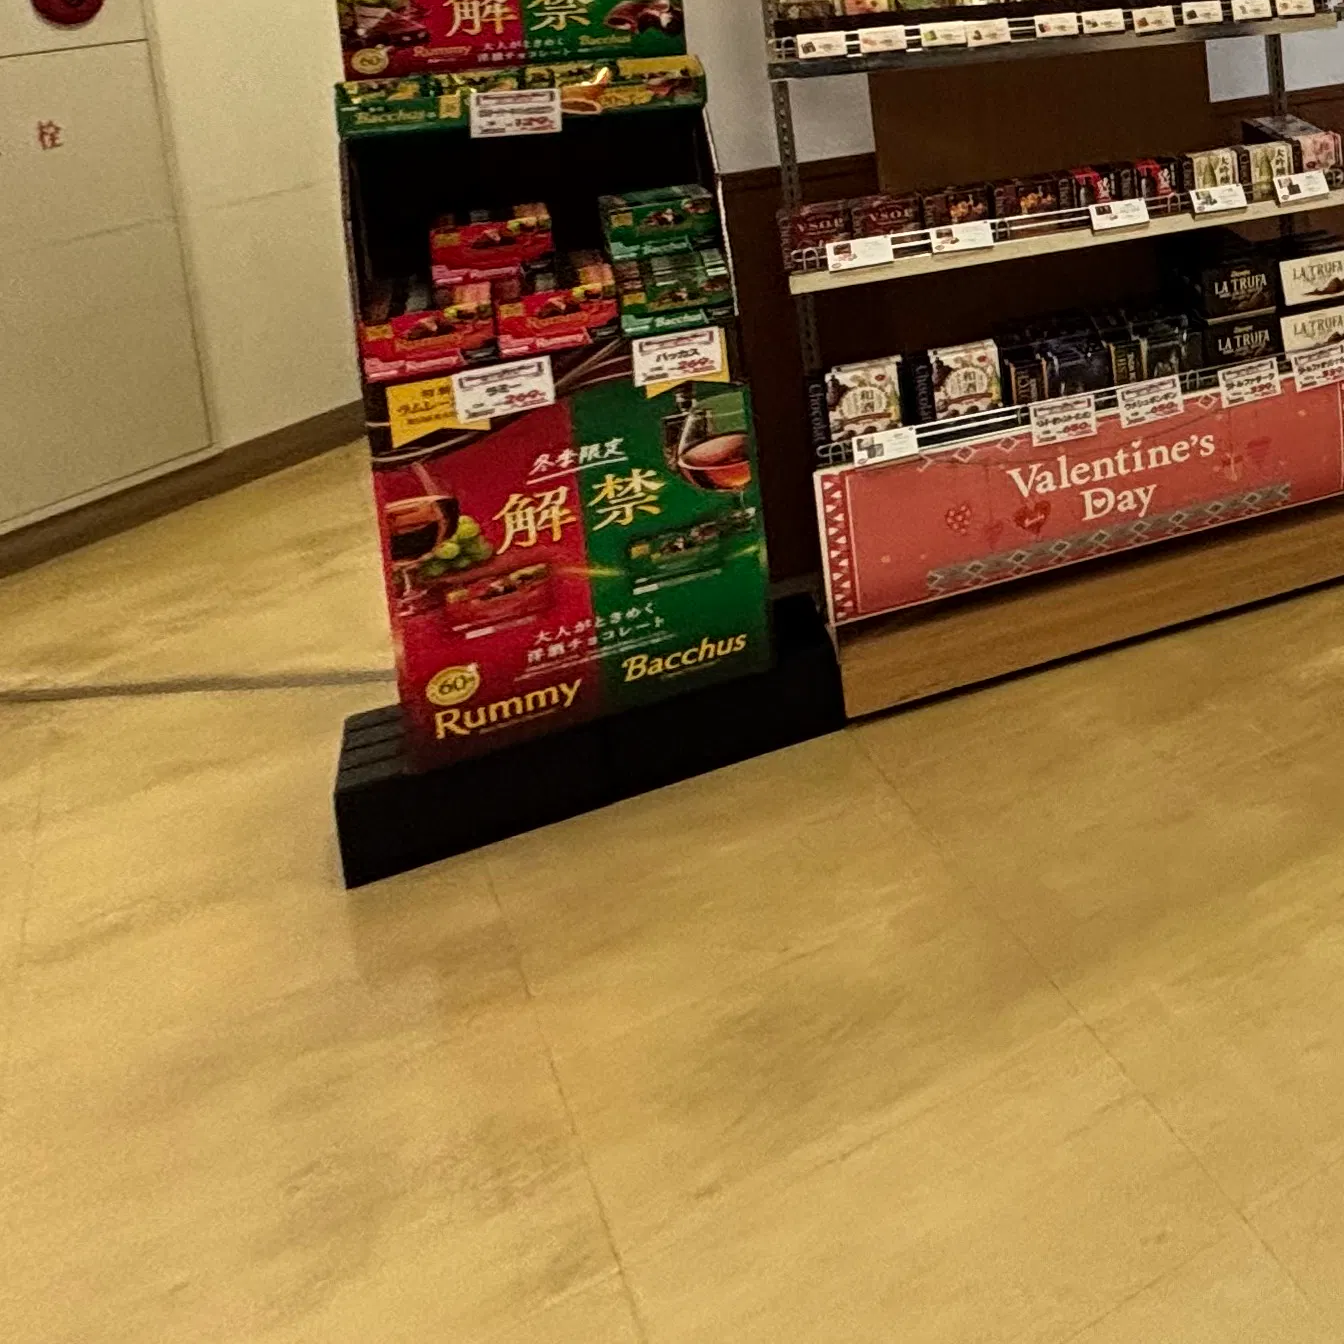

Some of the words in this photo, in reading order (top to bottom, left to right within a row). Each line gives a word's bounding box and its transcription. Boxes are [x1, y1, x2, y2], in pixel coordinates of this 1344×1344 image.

[656, 348, 701, 363] バッカス
[1006, 434, 1217, 500] Valentine's
[1081, 482, 1157, 522] Day
[622, 632, 749, 684] Bacchus
[434, 678, 583, 741] Rummy
